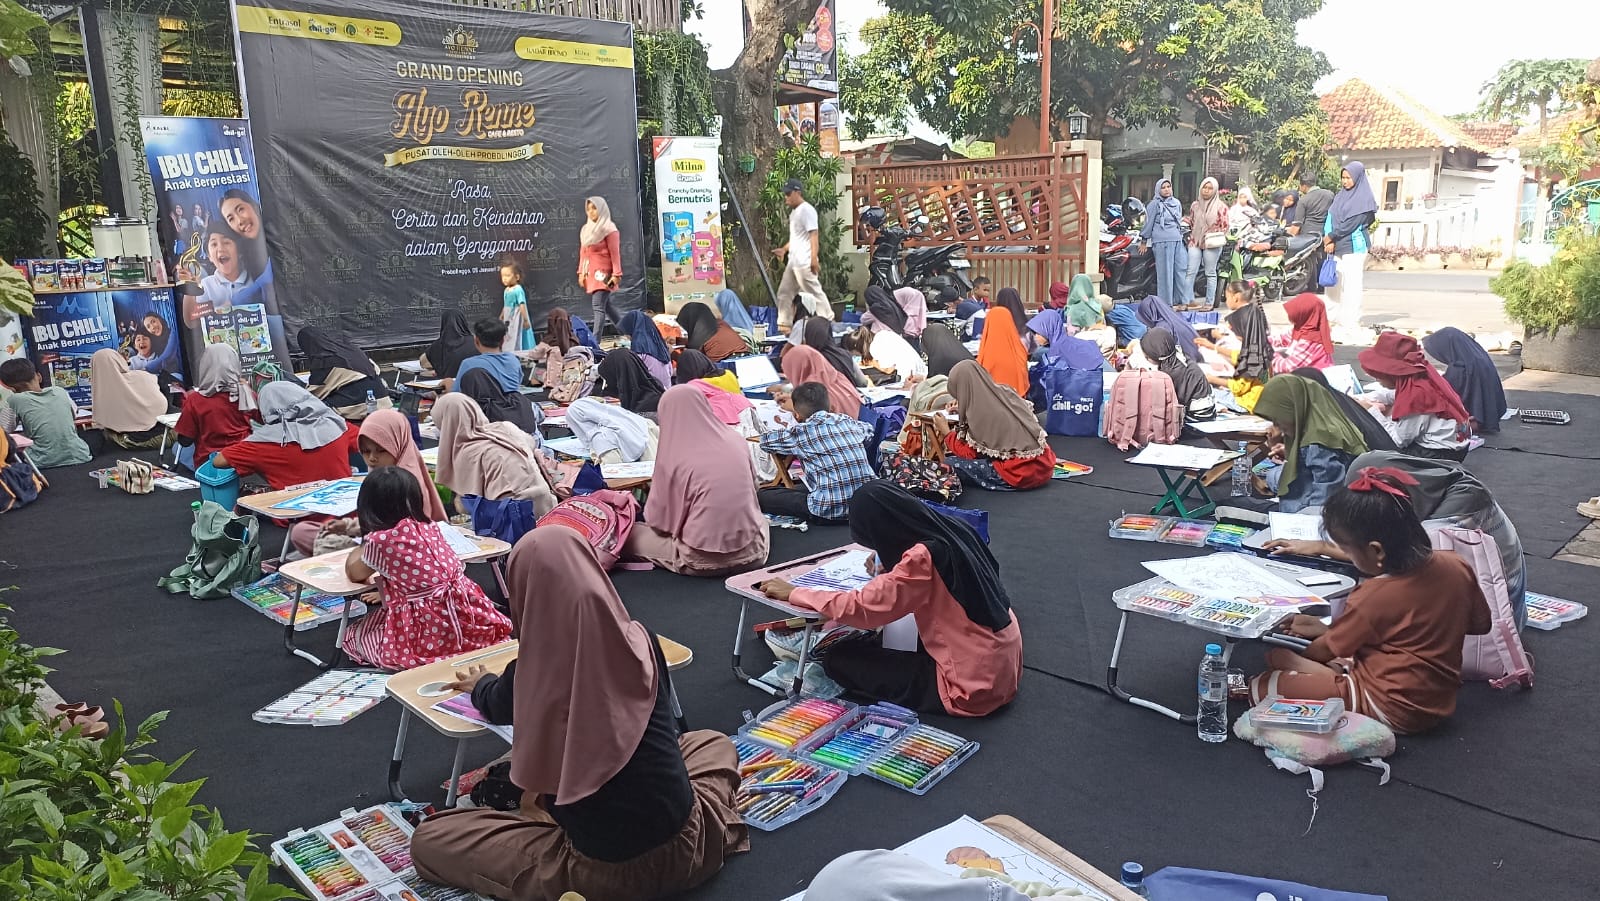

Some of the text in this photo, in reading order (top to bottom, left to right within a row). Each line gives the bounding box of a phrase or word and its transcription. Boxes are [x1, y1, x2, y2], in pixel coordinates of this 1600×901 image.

[396, 61, 523, 86] GRAND OPENING
[390, 87, 536, 144] Ayo Renne
[156, 148, 248, 179] IBU CHILL
[405, 148, 527, 160] PUSAT OLEH-OLEH PROBOLINGGO
[674, 161, 703, 171] Milna
[164, 172, 251, 192] Anak Berprestasi
[668, 194, 713, 204] Bernutrisi
[391, 207, 545, 230] Cerita dan Keindahan
[405, 240, 450, 257] dalam
[32, 316, 108, 343] IBU CHILL
[37, 334, 111, 351] Anak Berprestasi
